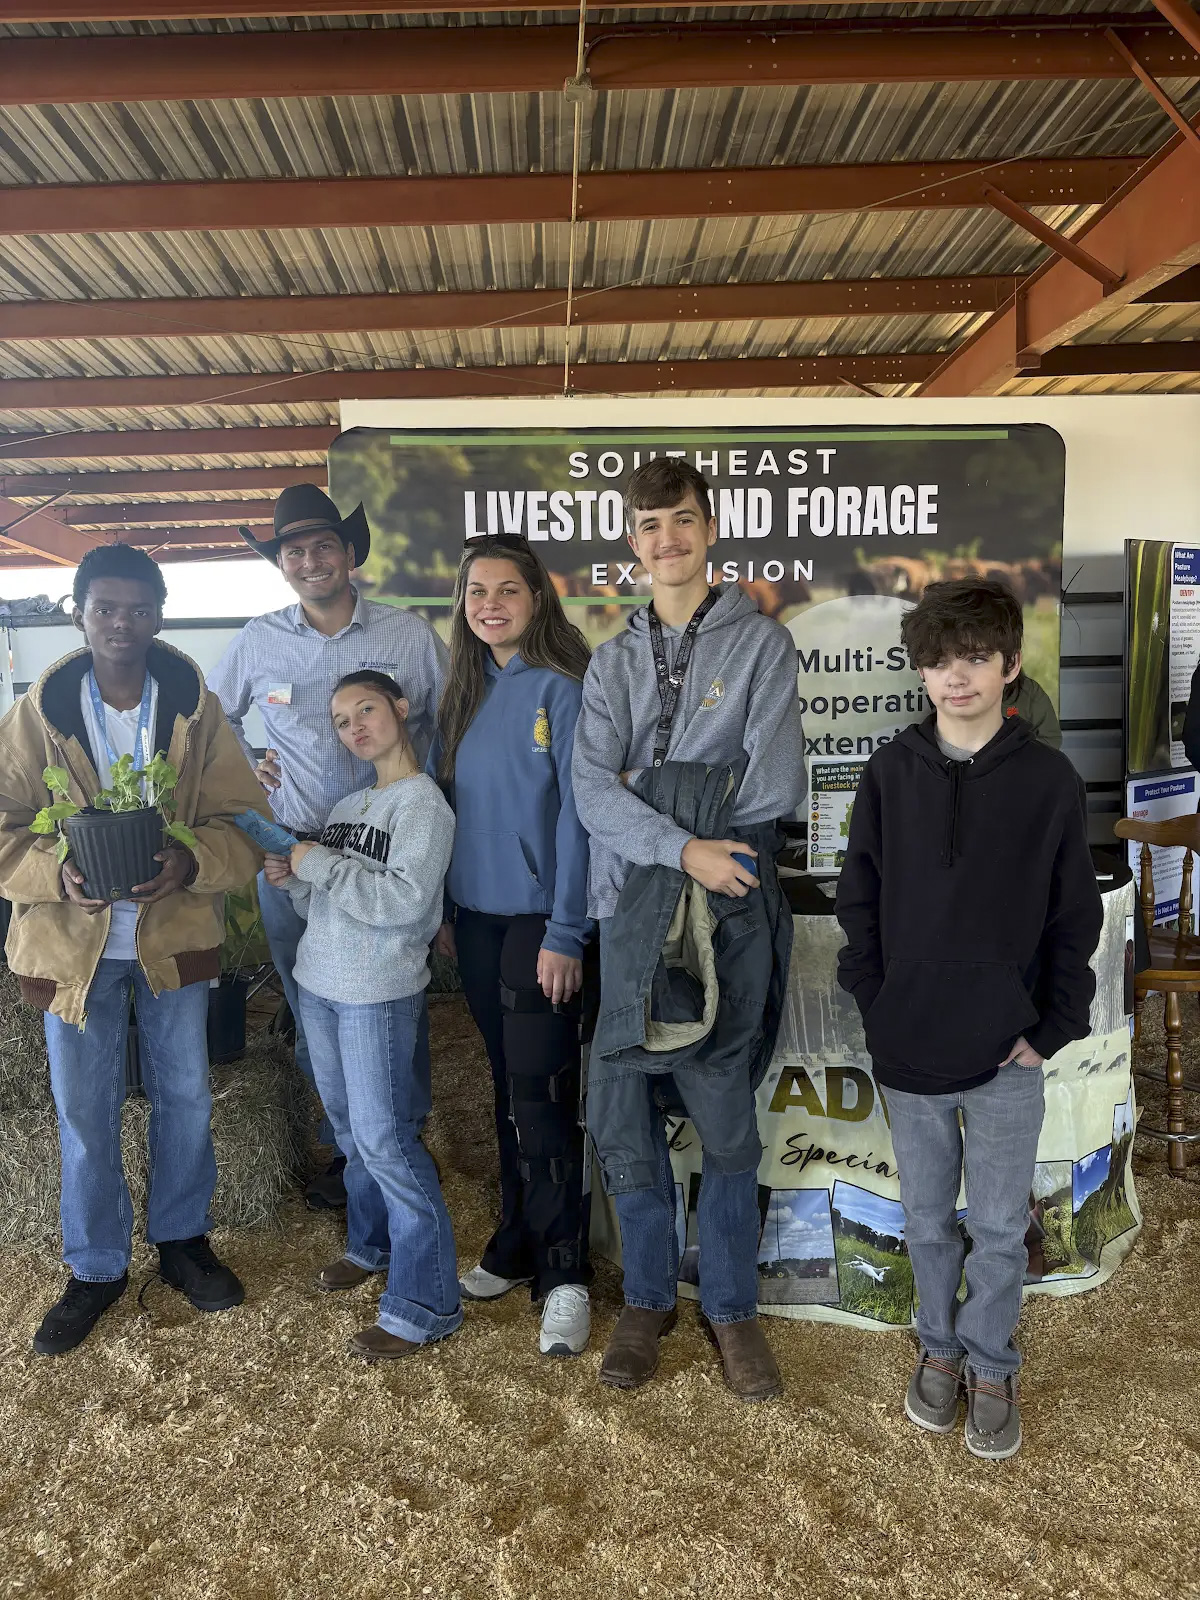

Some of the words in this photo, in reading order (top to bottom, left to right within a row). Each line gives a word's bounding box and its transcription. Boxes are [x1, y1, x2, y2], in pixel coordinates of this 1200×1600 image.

[568, 448, 838, 478] SOHEAST
[464, 490, 629, 542] LIVESTO
[787, 484, 940, 537] FORAGE
[1174, 562, 1190, 570] Pasture
[797, 646, 918, 673] Multi-St
[816, 766, 832, 775] What
[816, 776, 826, 784] you
[837, 772, 855, 782] facing
[822, 782, 851, 790] livestock
[852, 782, 860, 790] pr
[1144, 787, 1160, 796] Protect
[1170, 783, 1186, 792] Pasture
[1132, 810, 1148, 818] Manage
[768, 1065, 890, 1129] AD
[780, 1132, 900, 1180] Specia
